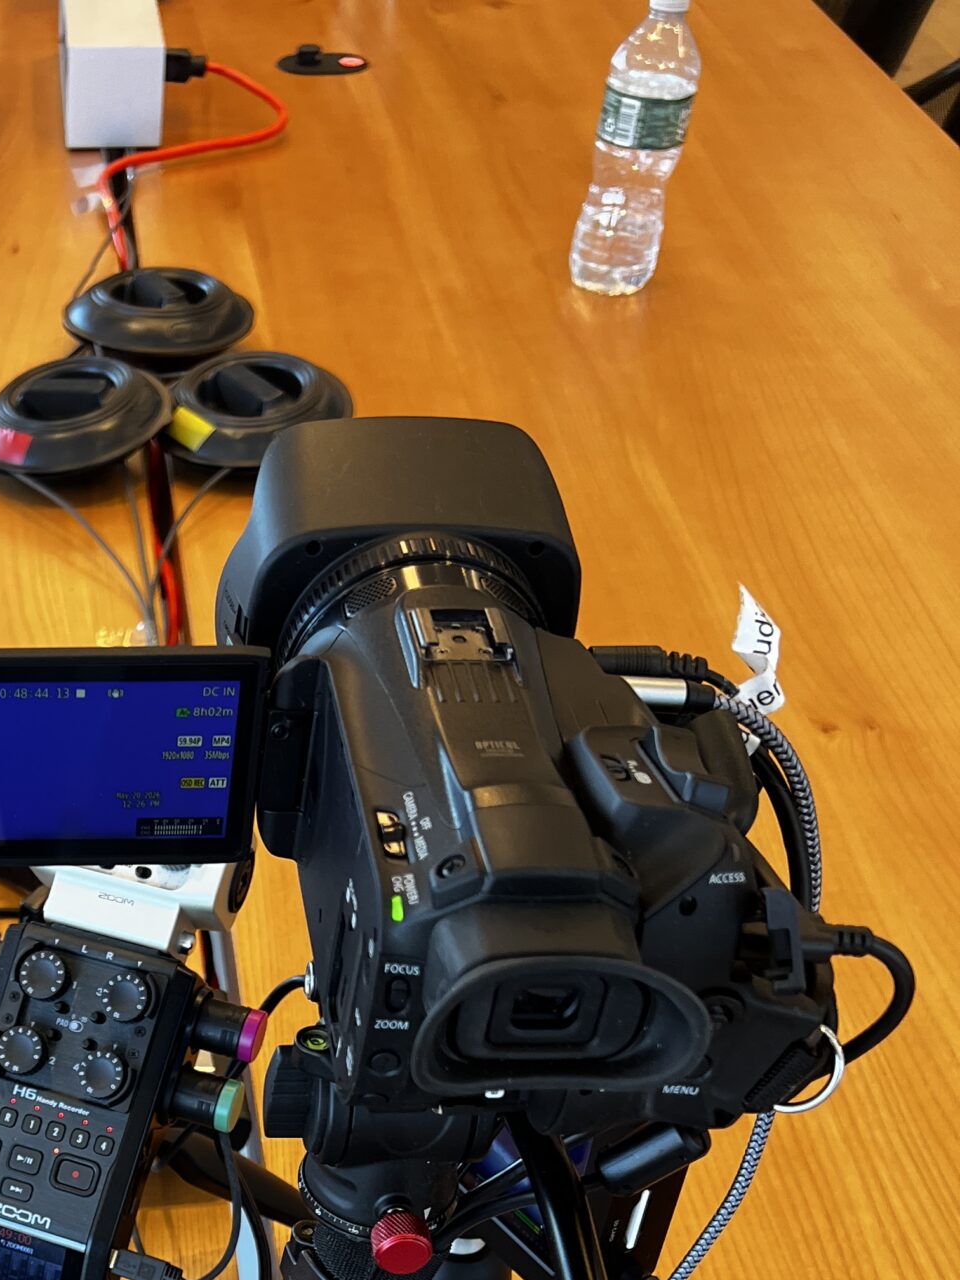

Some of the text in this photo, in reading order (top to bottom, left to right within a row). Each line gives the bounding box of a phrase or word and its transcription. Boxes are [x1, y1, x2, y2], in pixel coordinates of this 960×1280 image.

[202, 686, 236, 697] DC IN
[193, 706, 234, 717] 8h02m
[213, 736, 230, 746] MP4
[210, 778, 226, 787] ATT
[403, 791, 418, 820] CAMERA
[709, 872, 746, 884] ACCESS
[98, 891, 135, 907] ZOOM
[81, 944, 88, 954] L
[106, 951, 114, 961] R
[384, 963, 421, 976] FOCUS
[374, 1019, 409, 1031] ZOOM
[662, 1084, 700, 1096] MENU
[13, 1084, 90, 1117] H6 Handy Recorder
[4, 1112, 12, 1122] R
[53, 1127, 60, 1136] 2
[76, 1134, 83, 1143] 3
[100, 1141, 107, 1150] 4
